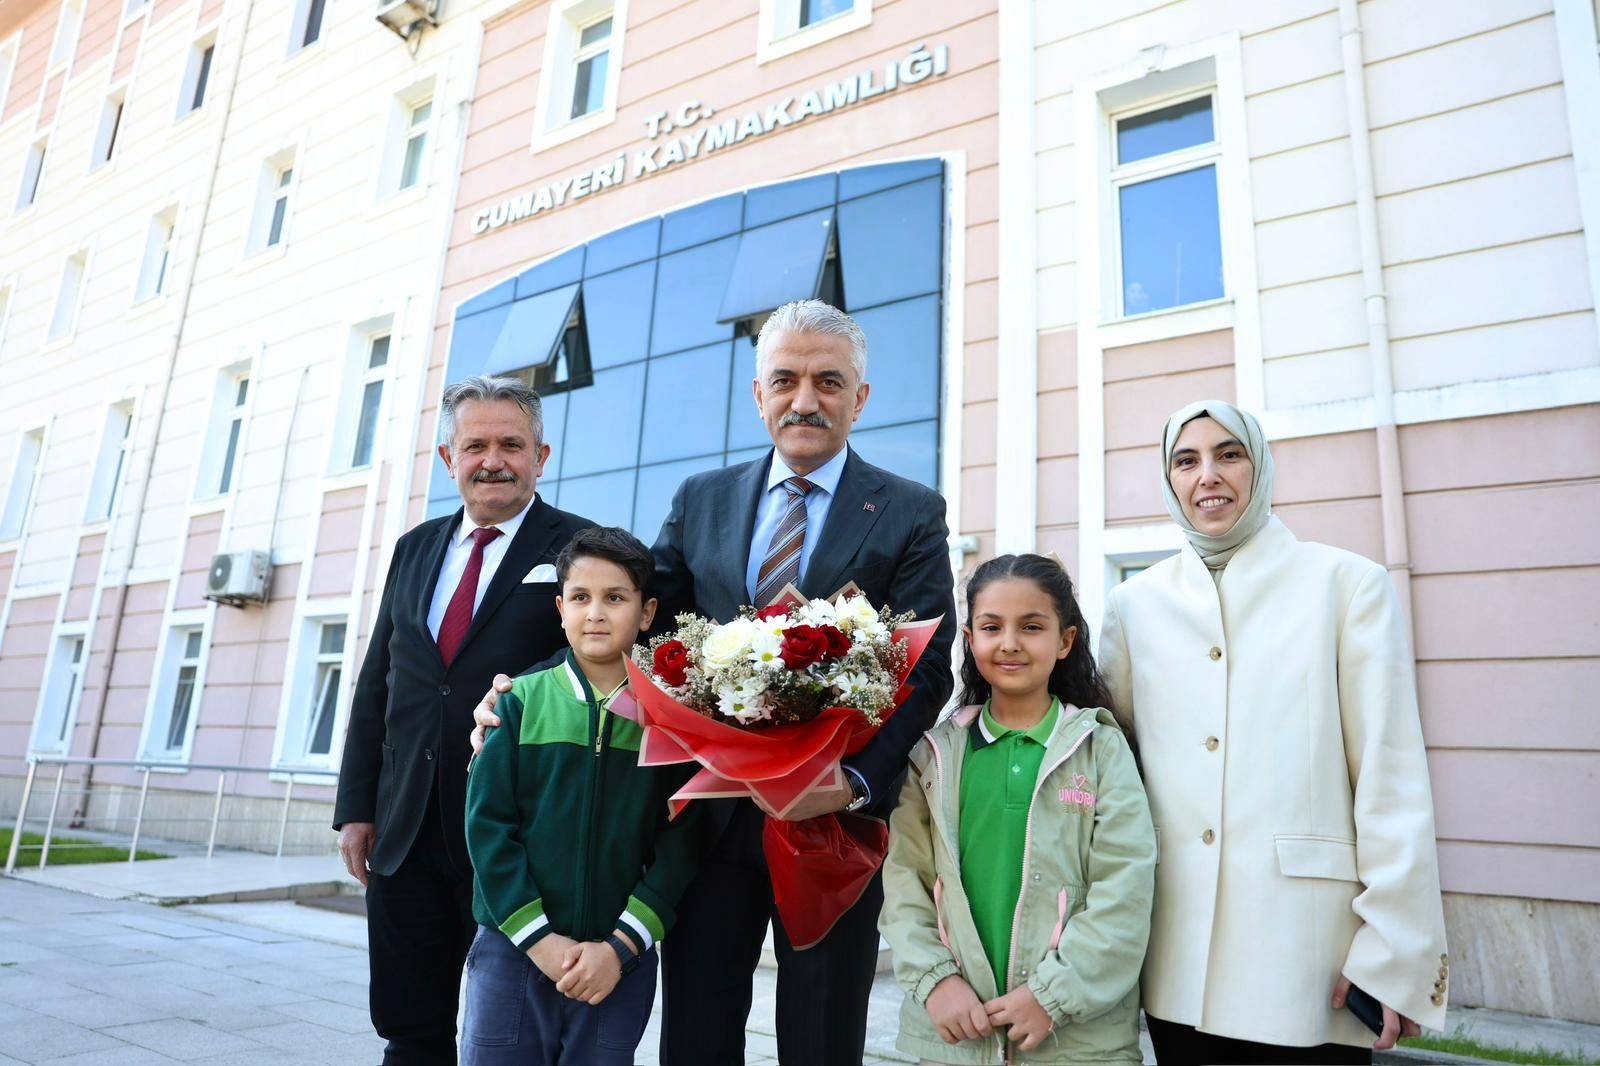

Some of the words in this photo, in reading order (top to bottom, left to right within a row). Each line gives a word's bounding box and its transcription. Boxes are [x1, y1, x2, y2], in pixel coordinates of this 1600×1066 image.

[470, 151, 626, 235] CUMAYERİ
[632, 43, 949, 178] KAYMAKAMLIĞI
[644, 99, 713, 140] T.C.
